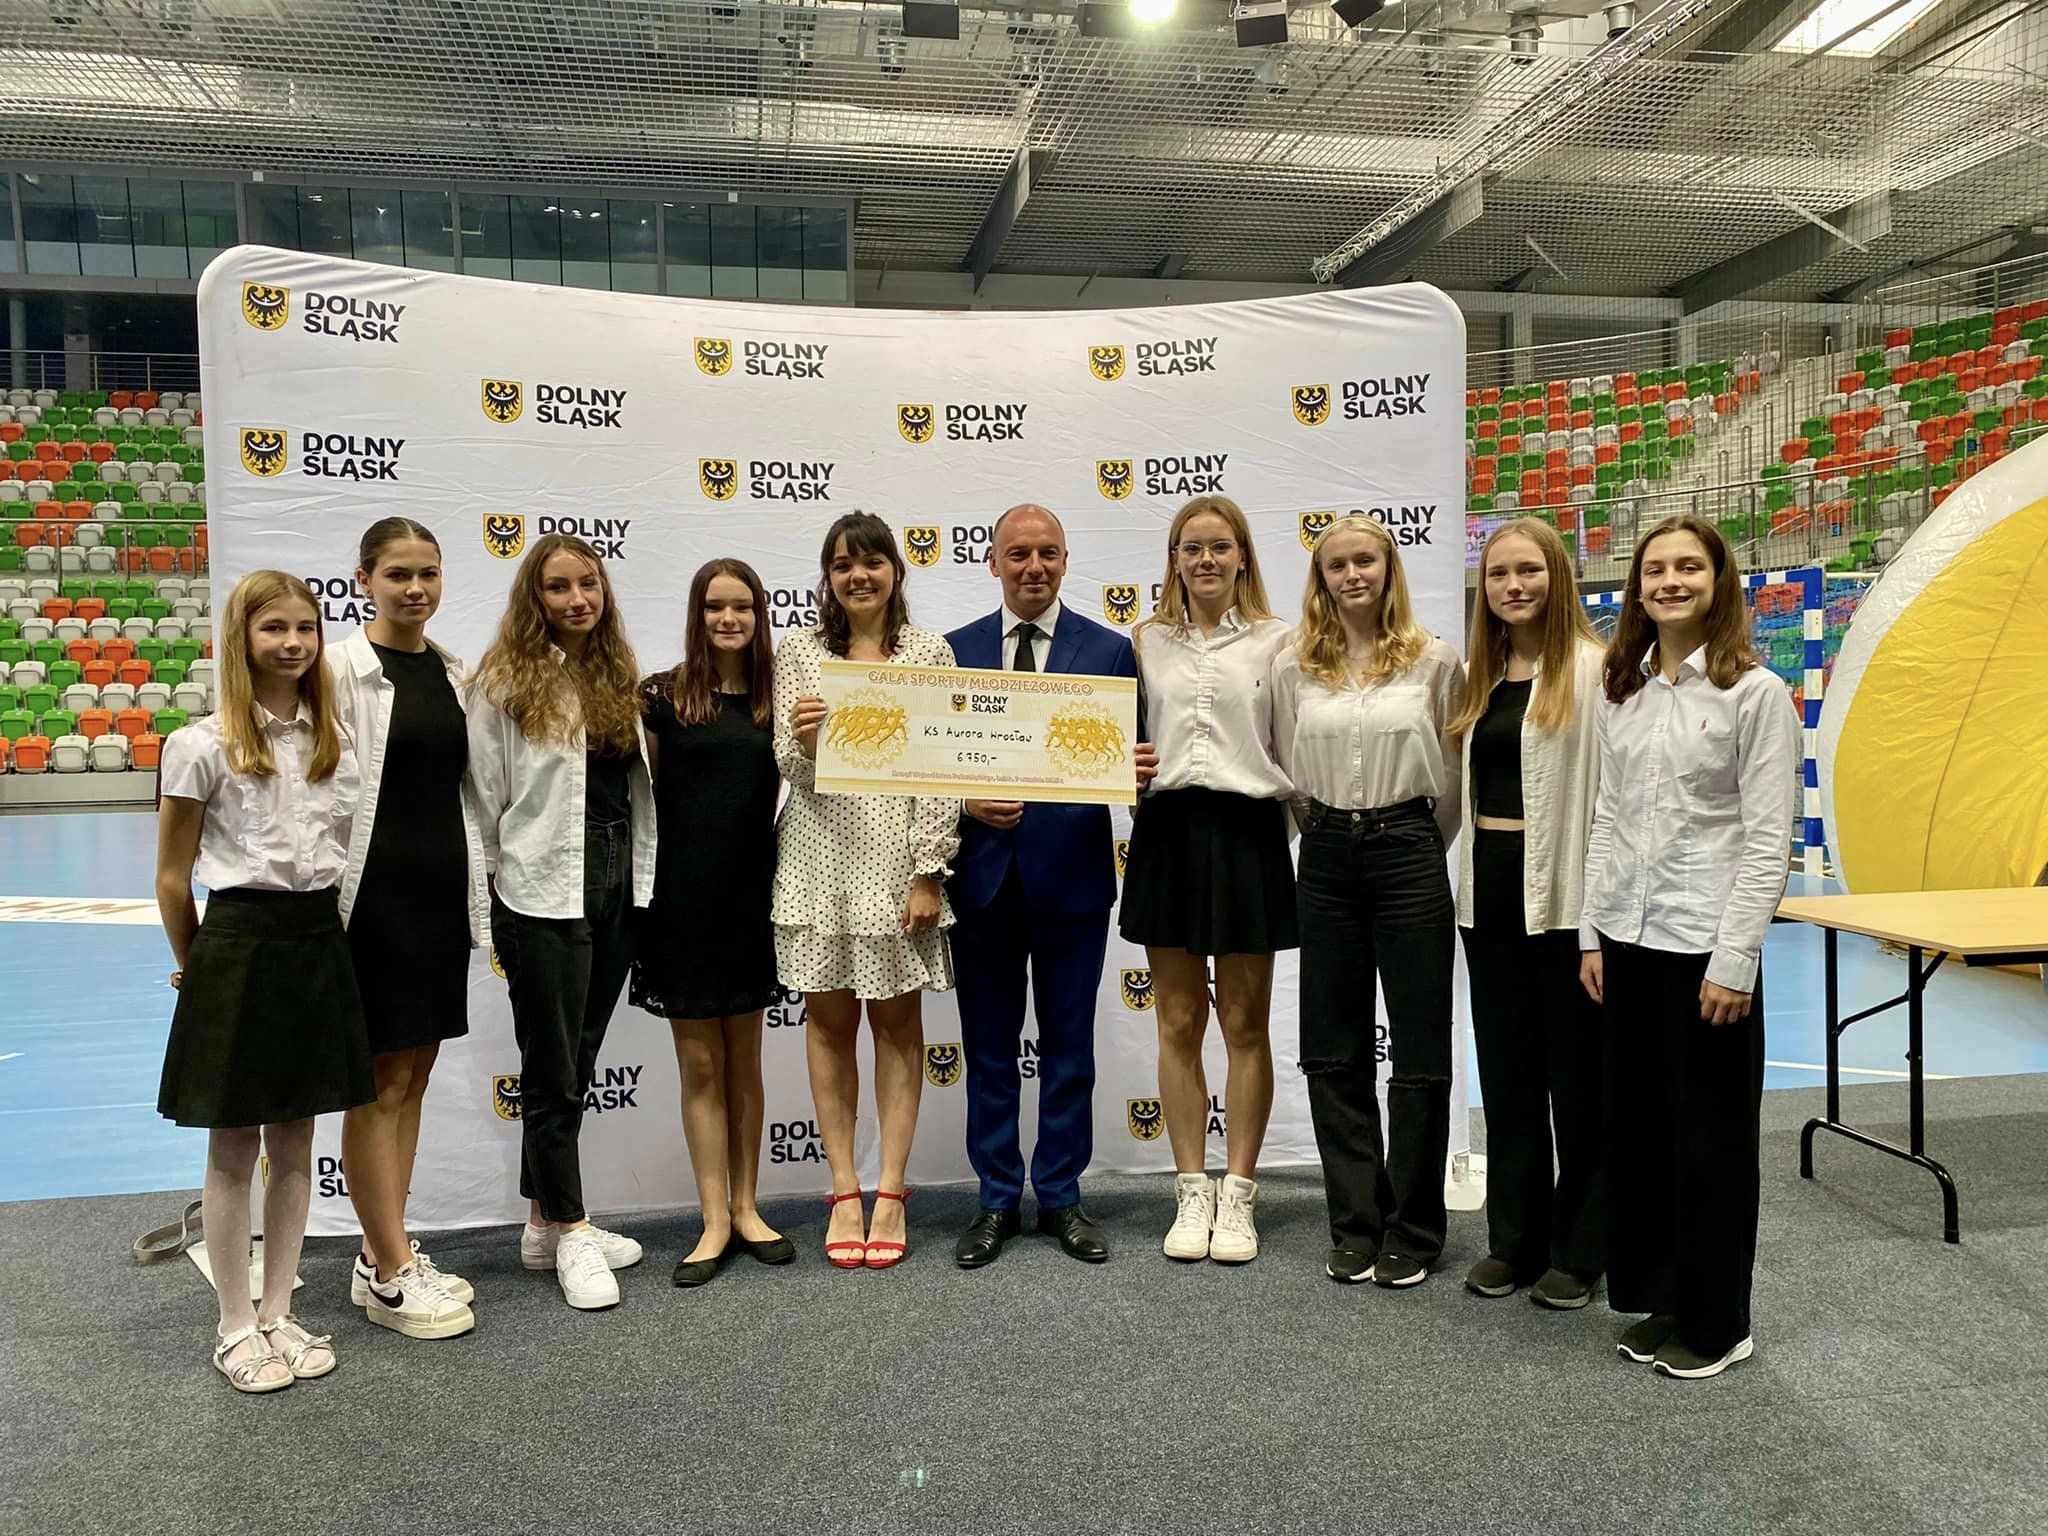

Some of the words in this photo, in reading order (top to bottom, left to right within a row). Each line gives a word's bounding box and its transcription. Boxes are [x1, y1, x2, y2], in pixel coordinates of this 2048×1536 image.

[304, 292, 406, 323] DOLNY
[303, 310, 399, 344] ŚLĄSK
[745, 341, 828, 361] DOLNY
[1137, 337, 1218, 359] DOLNY
[745, 356, 825, 380] ŚLĄSK
[1138, 354, 1216, 376] ŚLĄSK
[536, 384, 627, 408] DOLNY
[1342, 373, 1431, 400] DOLNY
[536, 401, 622, 430] ŚLĄSK
[945, 403, 1028, 422] DOLNY
[1343, 394, 1426, 420] ŚLĄSK
[946, 419, 1024, 443] ŚLĄSK
[303, 432, 406, 459] DOLNY
[302, 453, 399, 482] ŚLĄSK
[750, 460, 835, 481] DOLNY
[1145, 453, 1229, 476] DOLNY
[750, 477, 830, 503] ŚLĄSK
[1146, 473, 1225, 497] ŚLĄSK
[538, 516, 631, 538] DOLNY
[1349, 505, 1437, 526] OLNY
[305, 577, 366, 599] DOL
[764, 588, 820, 608] OLN
[321, 600, 377, 626] LĄS
[868, 670, 907, 685] GALA
[910, 673, 966, 689] SPORTU
[972, 694, 1009, 705] DOLNY
[924, 725, 939, 737] KS
[946, 727, 983, 740] Aurora
[590, 1065, 643, 1088] LNY
[583, 1088, 638, 1114] ĄSK
[770, 1120, 821, 1142] DOL
[770, 1140, 828, 1164] ŚLĄ
